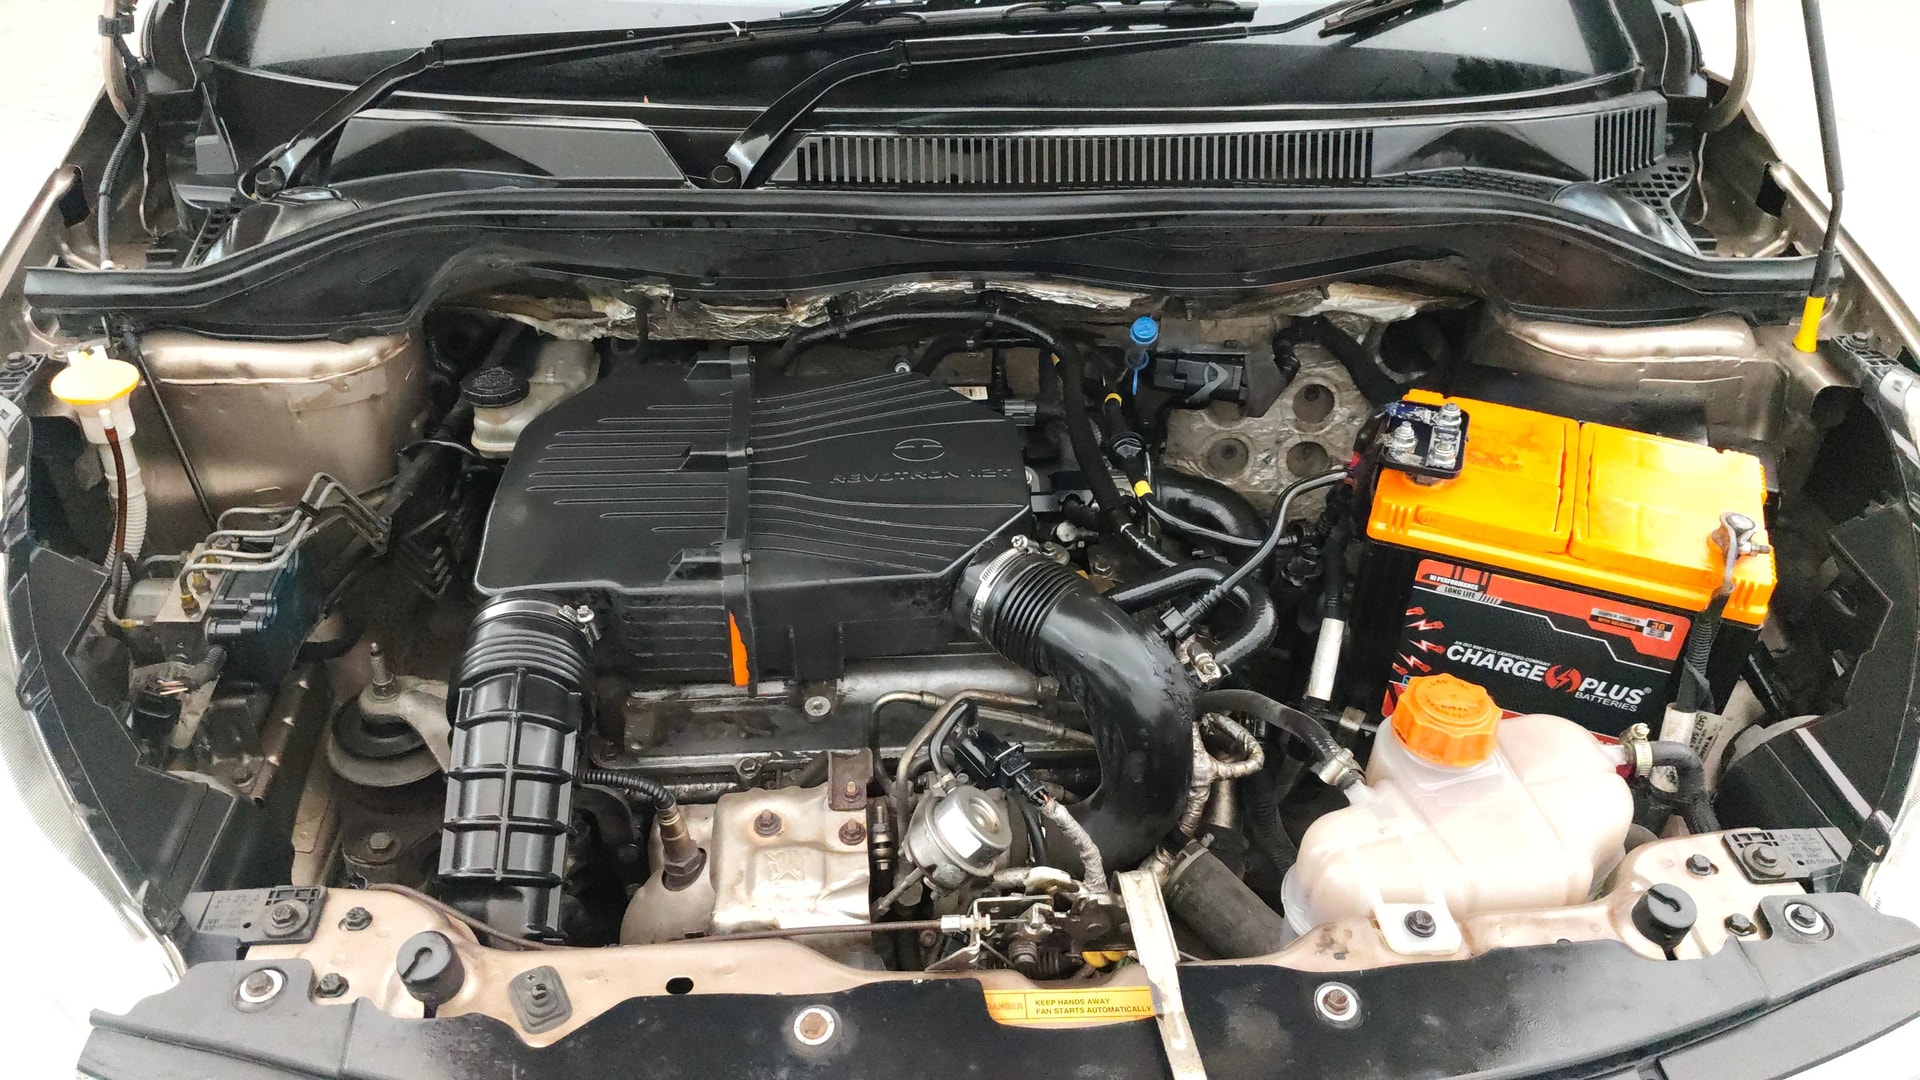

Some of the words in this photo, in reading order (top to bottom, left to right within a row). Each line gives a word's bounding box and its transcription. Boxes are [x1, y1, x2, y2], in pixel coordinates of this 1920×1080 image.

[1437, 576, 1479, 591] PERFORMANCE
[1444, 586, 1462, 595] LONG
[1463, 591, 1476, 599] LIFE
[1651, 622, 1666, 630] 36
[1446, 645, 1549, 682] CHARGE
[1577, 677, 1645, 705] PLUS
[1574, 691, 1638, 712] BATTERIES
[1035, 999, 1056, 1007] KEEP
[1057, 998, 1086, 1006] HANDS
[1087, 998, 1110, 1006] AWAY
[1036, 1007, 1053, 1015] FAN
[1053, 1006, 1085, 1015] STARTS
[1086, 1005, 1152, 1014] AUTOMATICALLY
